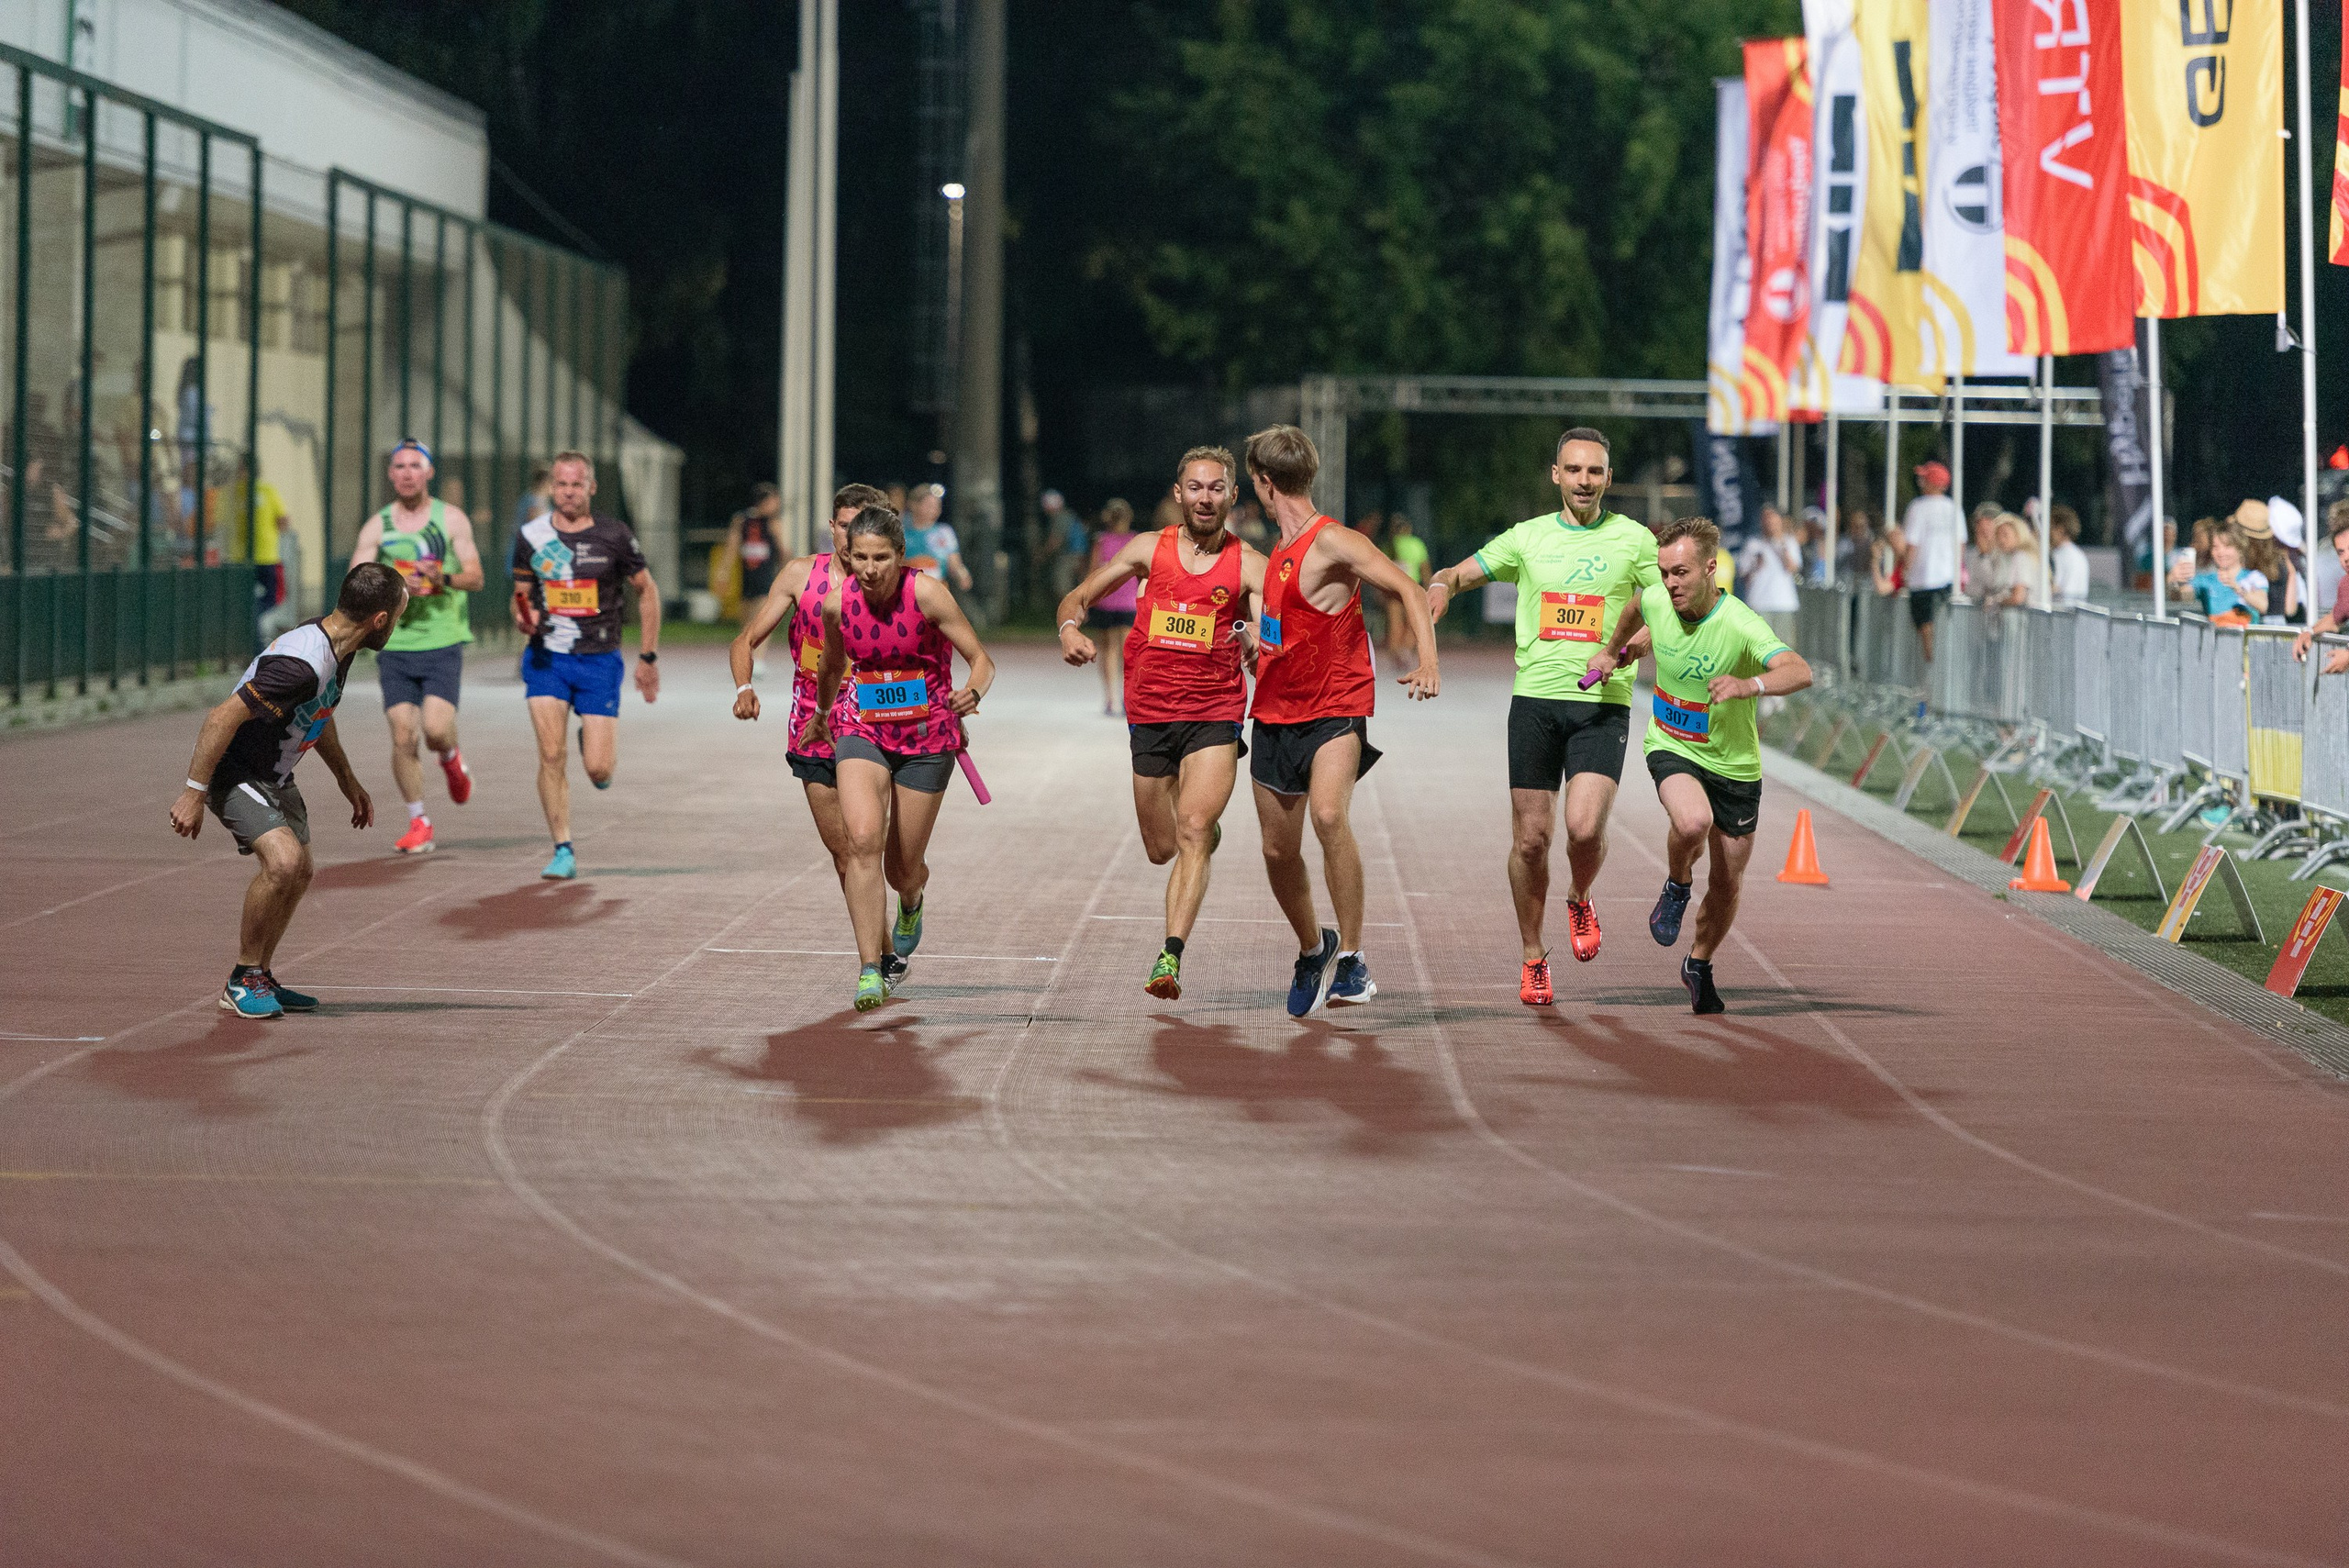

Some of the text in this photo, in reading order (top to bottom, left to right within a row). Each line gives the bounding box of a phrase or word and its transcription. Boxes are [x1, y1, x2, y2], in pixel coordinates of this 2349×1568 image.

[1165, 616, 1207, 638] 308 2
[1556, 608, 1597, 627] 307 2
[875, 686, 919, 705] 309 3
[1665, 707, 1701, 729] 307 3
